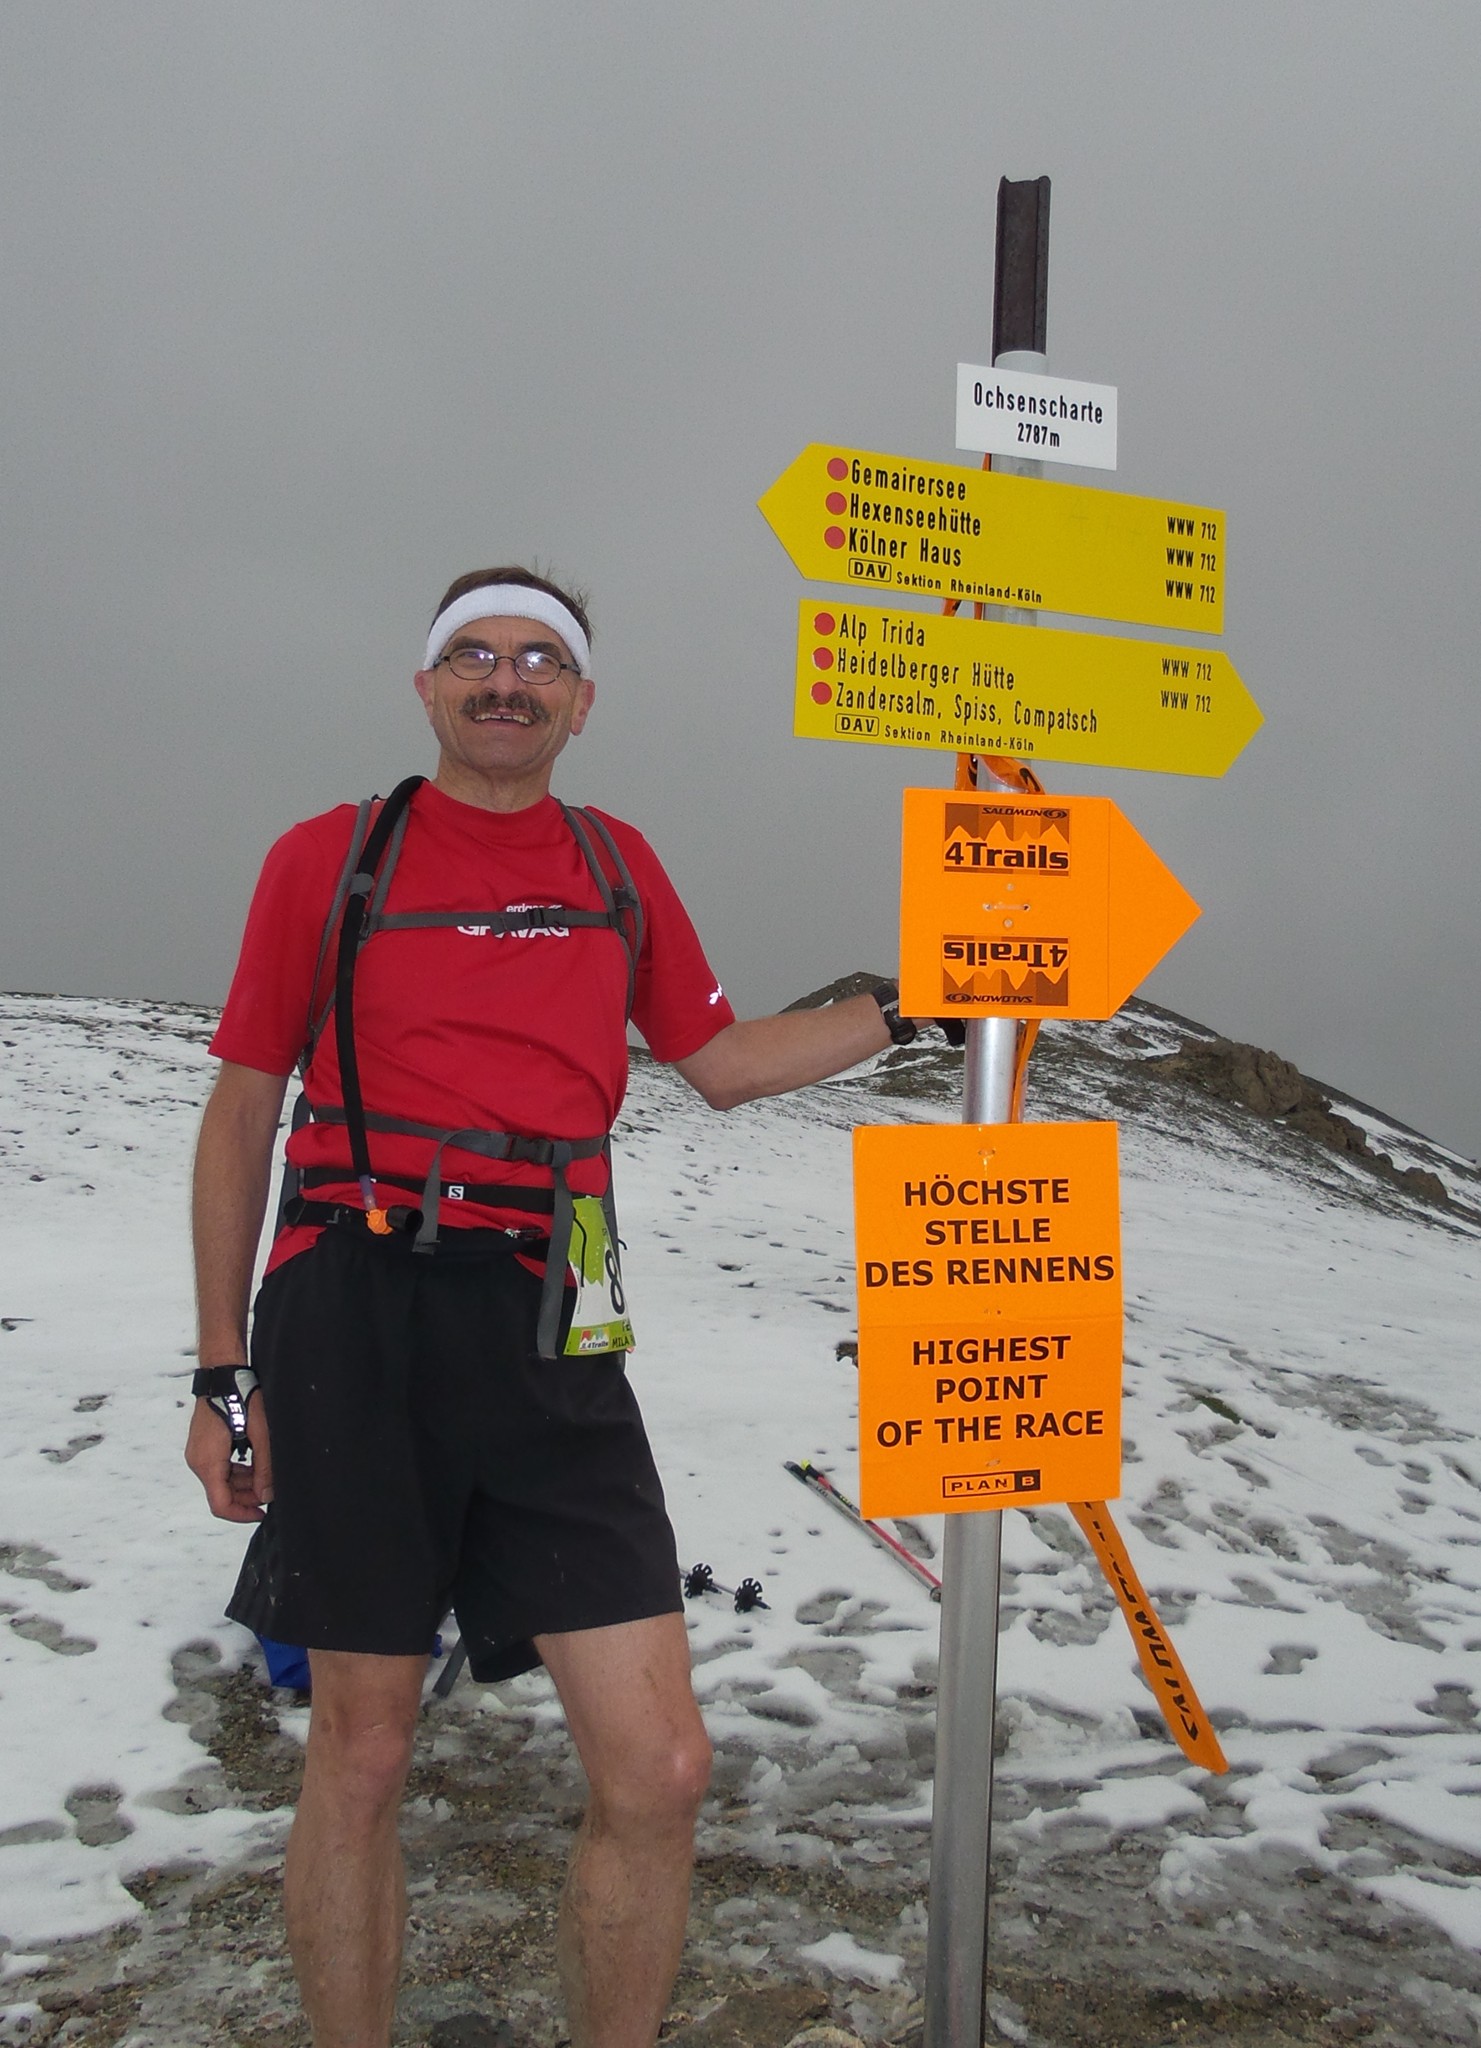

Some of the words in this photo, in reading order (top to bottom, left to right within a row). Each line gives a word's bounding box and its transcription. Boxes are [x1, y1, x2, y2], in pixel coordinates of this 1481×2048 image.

[974, 381, 1103, 425] Ochsenscharte
[1017, 422, 1060, 448] 2787m
[851, 458, 966, 501] Gemairersee
[1167, 515, 1195, 537] WWW
[1201, 521, 1217, 541] 712
[850, 492, 981, 537] Hexenseehütte
[1166, 547, 1194, 568] WWW
[1200, 552, 1216, 572] 712
[848, 526, 908, 560] Kölner
[919, 537, 962, 567] Haus
[1165, 579, 1194, 600] WWW
[1199, 584, 1216, 604] 712
[853, 561, 891, 583] DAV
[896, 571, 942, 590] Sektion
[950, 578, 1042, 604] Rheinland-Köln
[839, 613, 867, 646] Alp
[881, 617, 925, 647] Trida
[1161, 658, 1190, 678] WWW
[1196, 662, 1212, 682] 712
[837, 647, 960, 689] Heidelberger
[972, 661, 1015, 691] Hütte
[1160, 690, 1189, 710] WWW
[1195, 694, 1211, 713] 712
[836, 682, 942, 720] Zandersalm,
[954, 695, 1002, 726] Spiss,
[1014, 700, 1097, 734] Compatsch
[840, 716, 875, 734] DAV
[884, 724, 931, 742] Sektion
[940, 729, 1034, 752] Rheinland-Köln
[981, 806, 1041, 818] SALOMON
[944, 841, 1069, 869] 4Trails
[943, 942, 1068, 968] 4Trails
[972, 994, 1033, 1004] SALOMON
[904, 1173, 1070, 1207] HÖCHSTE
[925, 1217, 1051, 1246] STELLE
[865, 1259, 934, 1288] DES
[946, 1255, 1115, 1286] RENNENS
[913, 1335, 1072, 1366] HIGHEST
[936, 1374, 1048, 1404] POINT
[876, 1419, 923, 1448] OF
[934, 1415, 1002, 1444] THE
[1015, 1410, 1104, 1439] RACE
[951, 1478, 1008, 1492] PLAN
[1019, 1471, 1036, 1488] B
